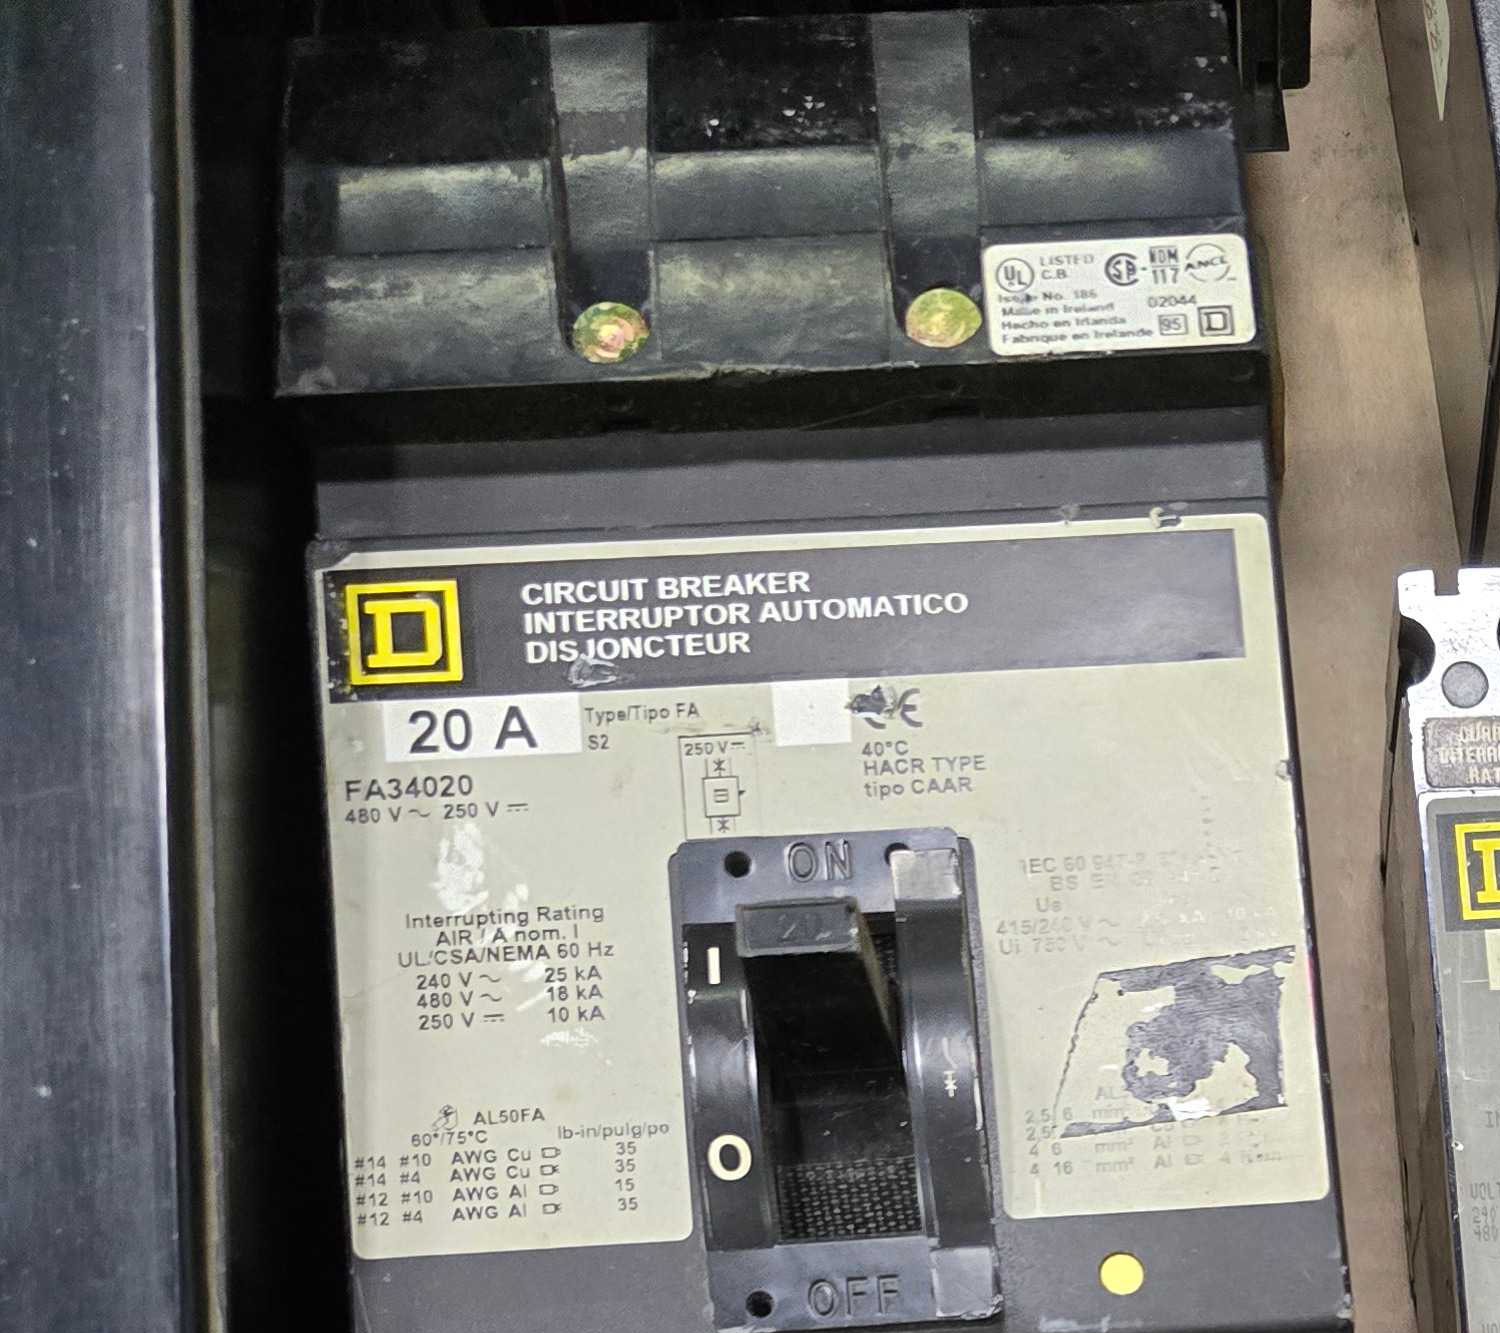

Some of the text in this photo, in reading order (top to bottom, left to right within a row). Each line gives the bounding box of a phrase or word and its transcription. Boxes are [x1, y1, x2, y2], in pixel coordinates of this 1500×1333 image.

[1040, 254, 1094, 266] LISTED
[1063, 302, 1114, 314] Ireland
[1147, 295, 1197, 308] 02044
[1054, 315, 1126, 328] en Irlanda
[1072, 331, 1090, 340] en
[521, 571, 810, 606] CIRCUIT BREAKER
[523, 593, 969, 635] INTERRUPTOR AUTOMATICO
[363, 598, 442, 670] D
[525, 633, 751, 665] DISJONCTEUR
[584, 703, 700, 724] Type/Tipo FA
[408, 705, 538, 754] 20 A
[588, 735, 609, 750] S2
[684, 742, 728, 757] 250 V
[862, 741, 908, 757] 40°C
[864, 755, 986, 776] HACR TYPE
[345, 775, 474, 801] FA34020
[864, 778, 972, 800] tipo CAAR
[345, 801, 499, 823] 480 V 250 V
[786, 840, 852, 882] ON
[406, 905, 605, 929] Interrupting Rating
[436, 930, 471, 946] AIR
[557, 942, 614, 959] 60 Hz
[417, 965, 602, 989] 240 V 25 kA
[417, 983, 603, 1008] 480 V 18 kA
[419, 1006, 605, 1031] 250 V 10 kA
[473, 1108, 545, 1126] AL50FA
[354, 1142, 637, 1170] #14 #10 AWG Cu 35
[354, 1159, 635, 1188] #14 #4 AWG Cu 35
[355, 1178, 634, 1208] #12 #10 AWG Al 15
[357, 1198, 638, 1227] #12 #4 AWG Al 35
[807, 1274, 901, 1317] OFF
